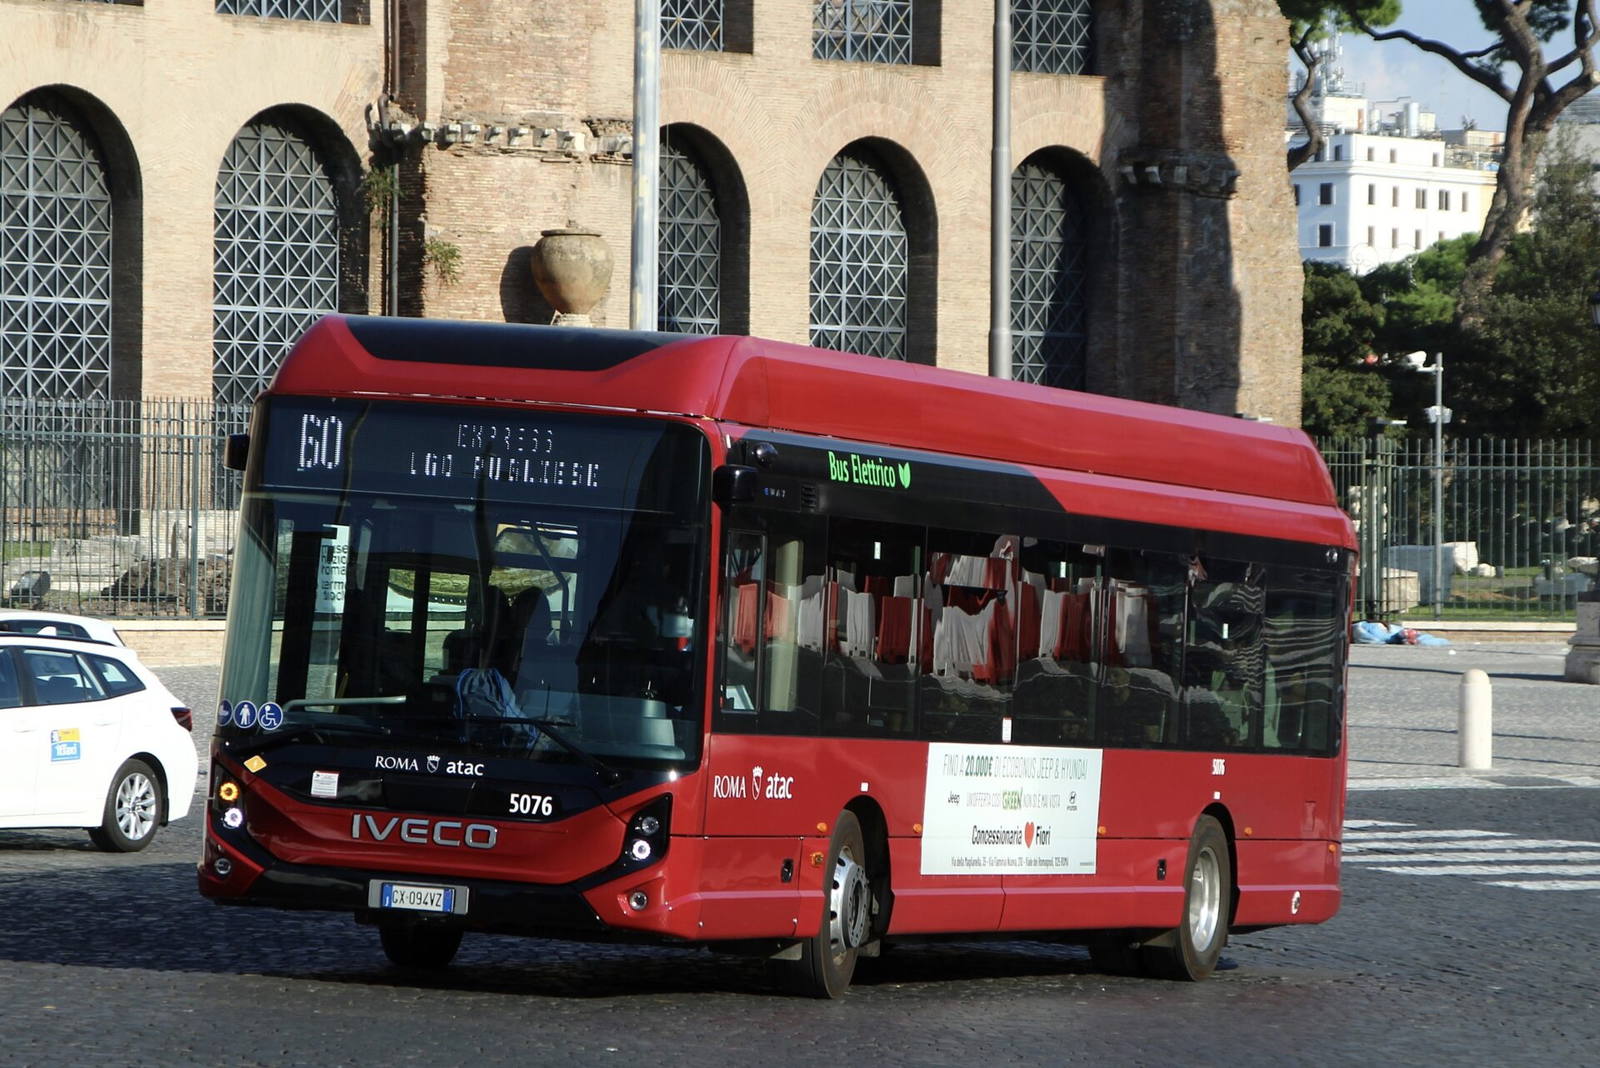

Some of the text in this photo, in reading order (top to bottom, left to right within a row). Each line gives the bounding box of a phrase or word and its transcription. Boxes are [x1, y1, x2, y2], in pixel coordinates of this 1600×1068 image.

[299, 413, 343, 469] 60
[410, 451, 453, 477] LGO
[828, 451, 896, 487] Bus Elettrico
[375, 755, 485, 777] ROMA atac
[965, 754, 993, 777] 20.000€
[1037, 757, 1054, 780] JEEP
[713, 772, 794, 799] ROMA atac
[1002, 787, 1023, 810] GREEN
[508, 793, 554, 816] 5076
[350, 813, 498, 849] IVECO
[971, 825, 1051, 846] Concessionaria Fiori
